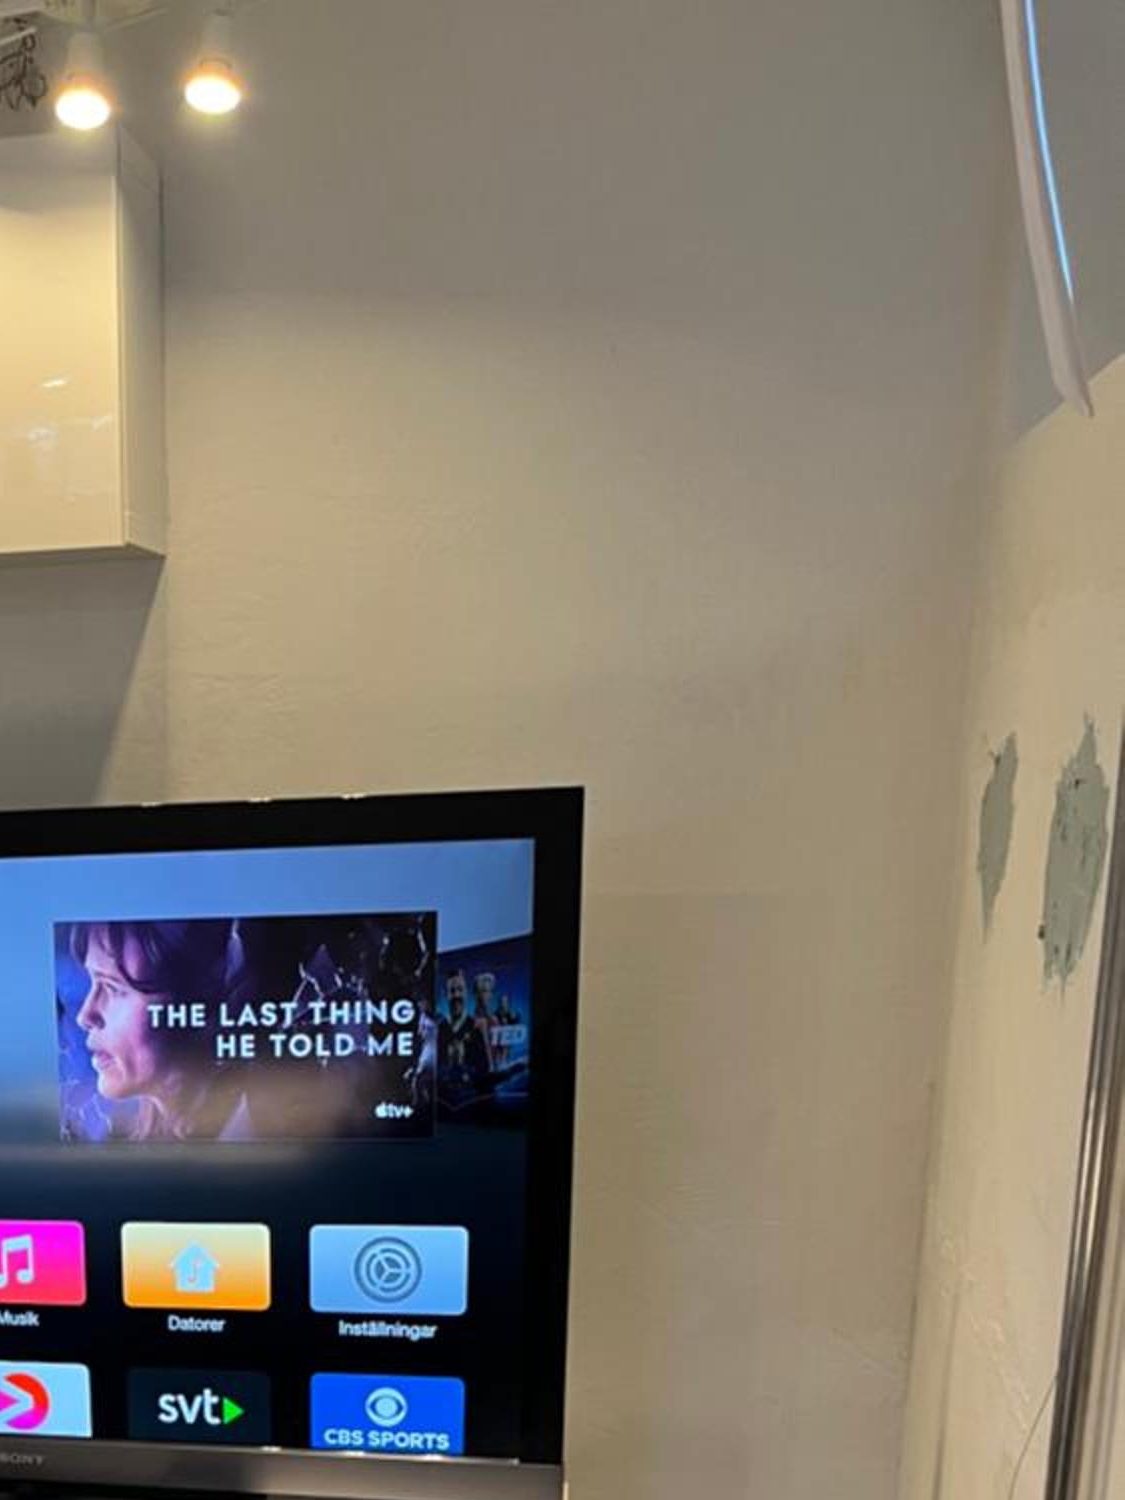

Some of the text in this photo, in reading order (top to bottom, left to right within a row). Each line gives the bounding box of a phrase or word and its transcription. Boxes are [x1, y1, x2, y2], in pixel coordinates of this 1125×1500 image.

[147, 1000, 416, 1029] THE LAST THING
[215, 1032, 415, 1060] HE TOLD ME
[167, 1315, 226, 1333] Datorer
[338, 1320, 437, 1341] Inställningar
[157, 1388, 221, 1426] svt
[324, 1428, 451, 1451] CBS SPORTS
